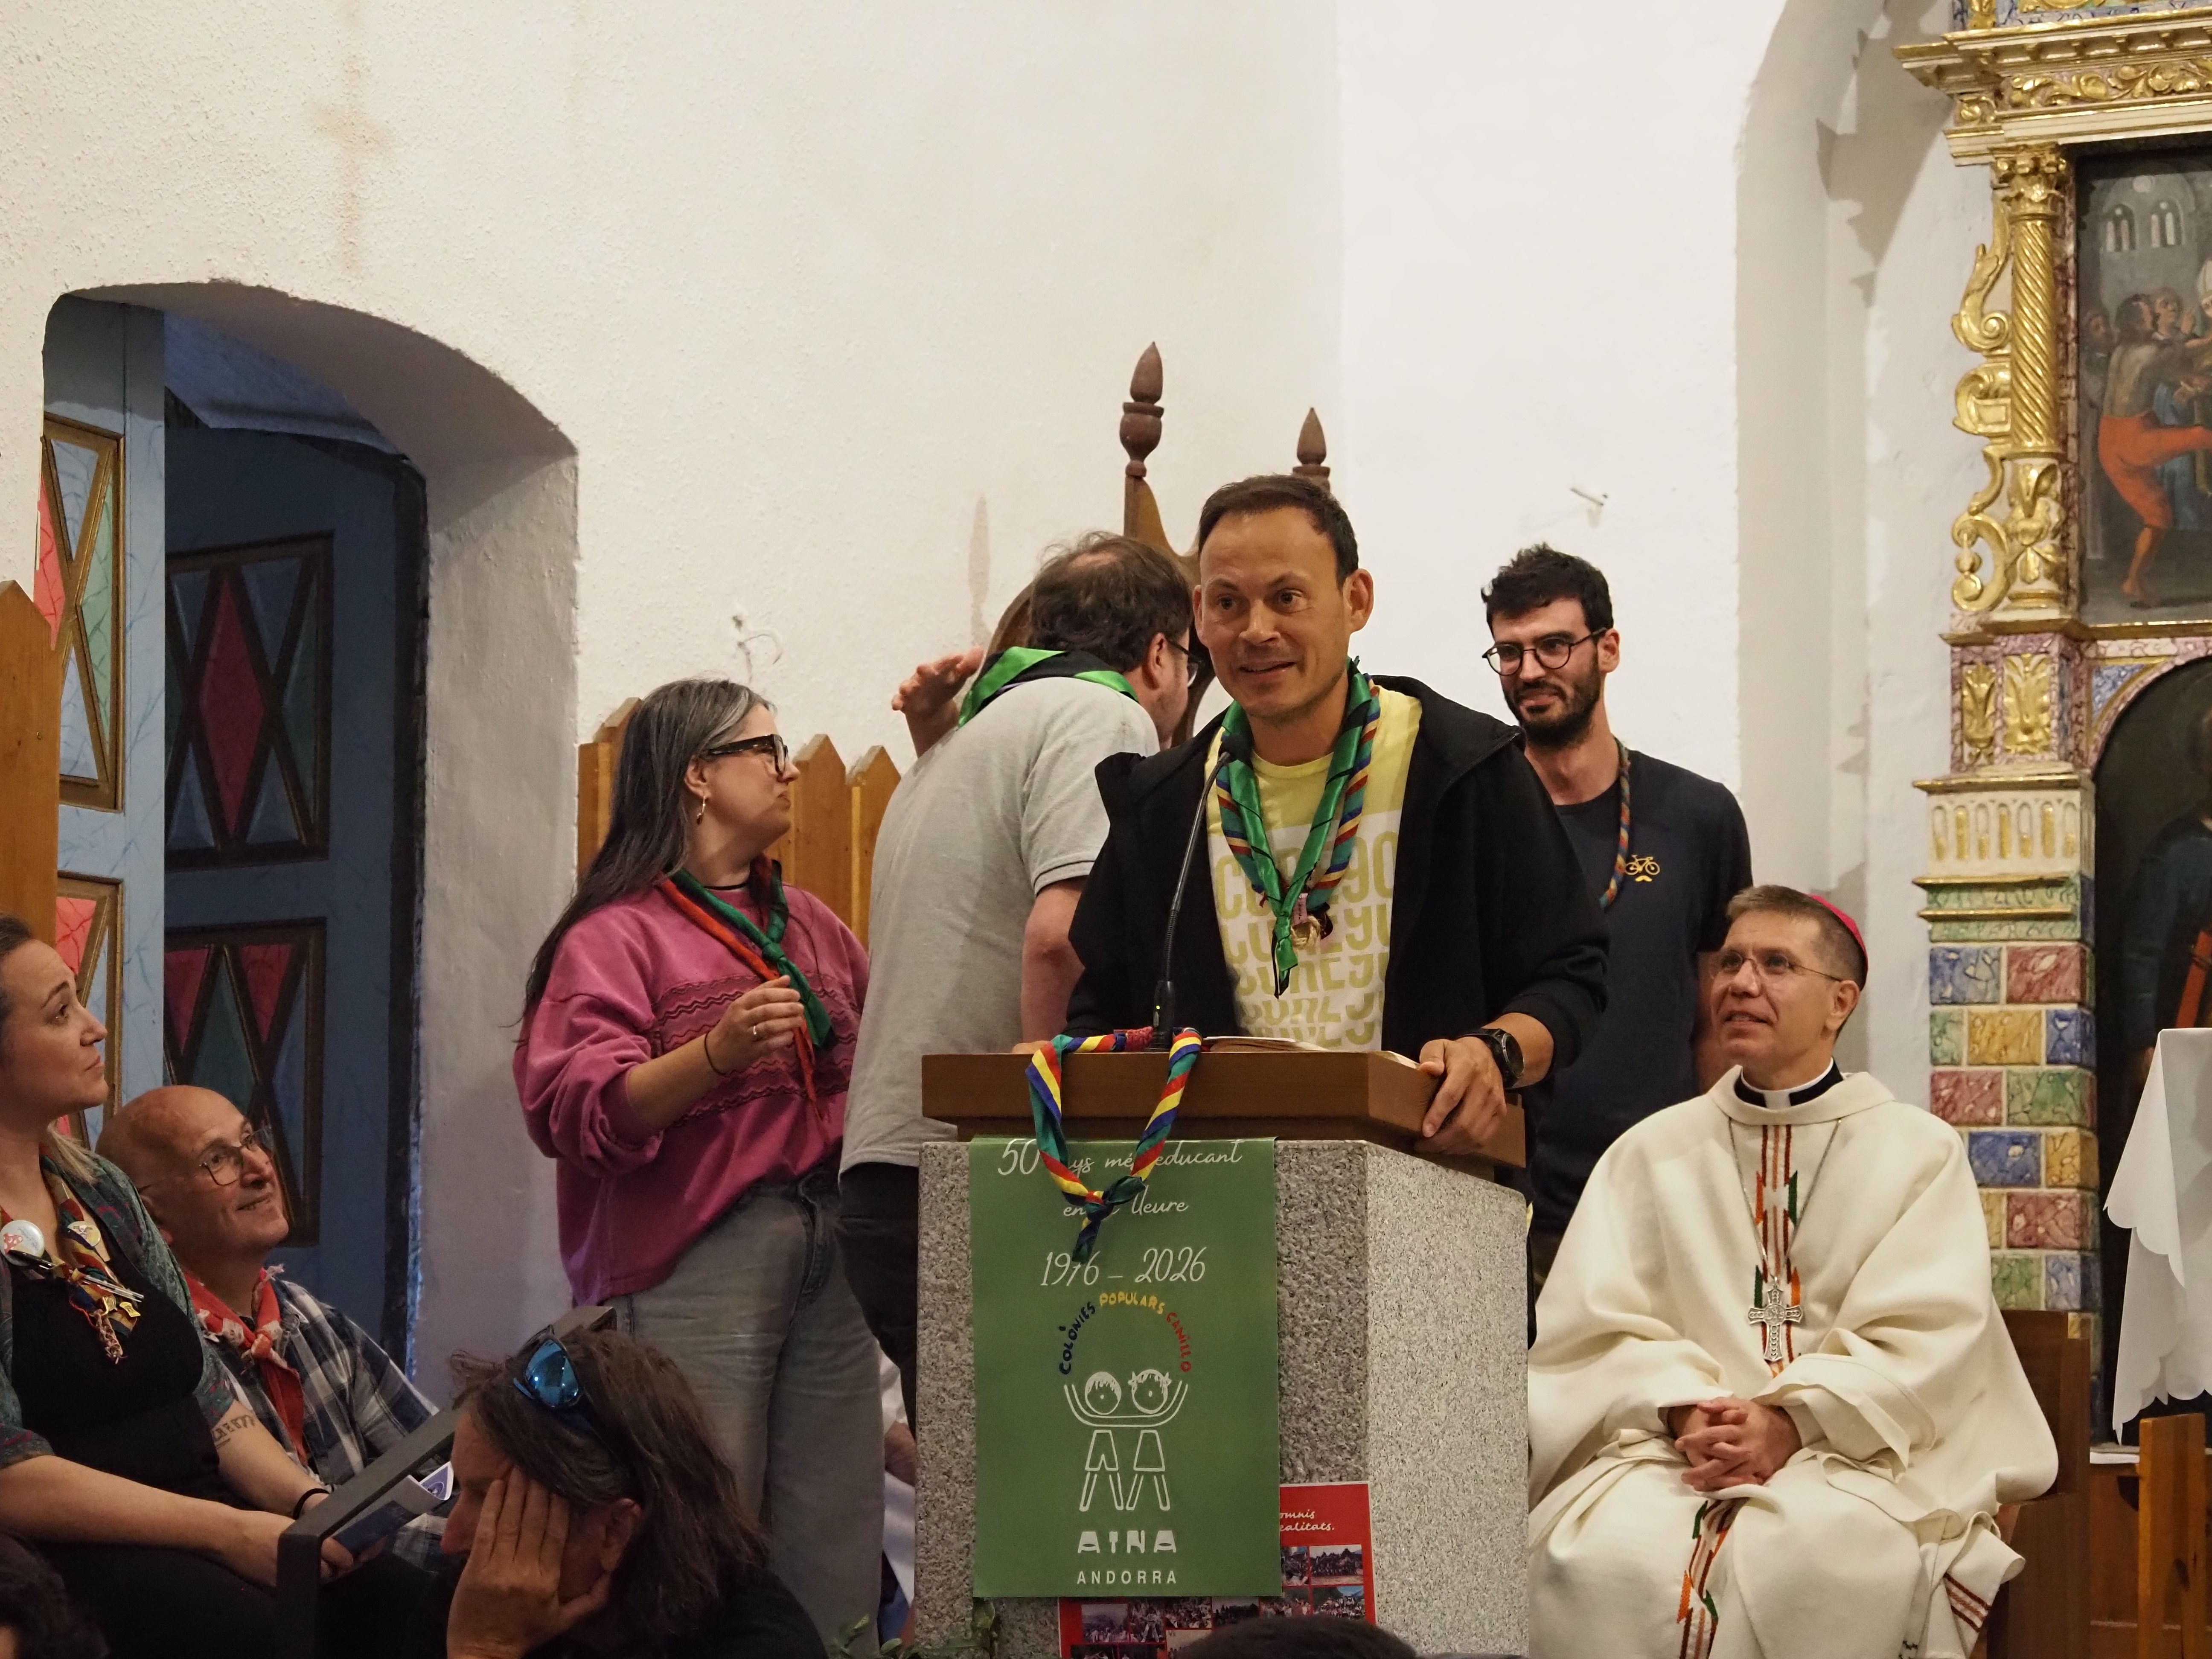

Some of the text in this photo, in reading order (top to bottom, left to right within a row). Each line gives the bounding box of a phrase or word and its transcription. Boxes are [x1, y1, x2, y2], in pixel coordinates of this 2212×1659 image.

[1155, 1139, 1243, 1166] educant
[1135, 1246, 1207, 1283] 2026
[1099, 1291, 1165, 1315] POPULARS
[1077, 1530, 1176, 1554] AINA
[1077, 1570, 1176, 1584] ANDORRA
